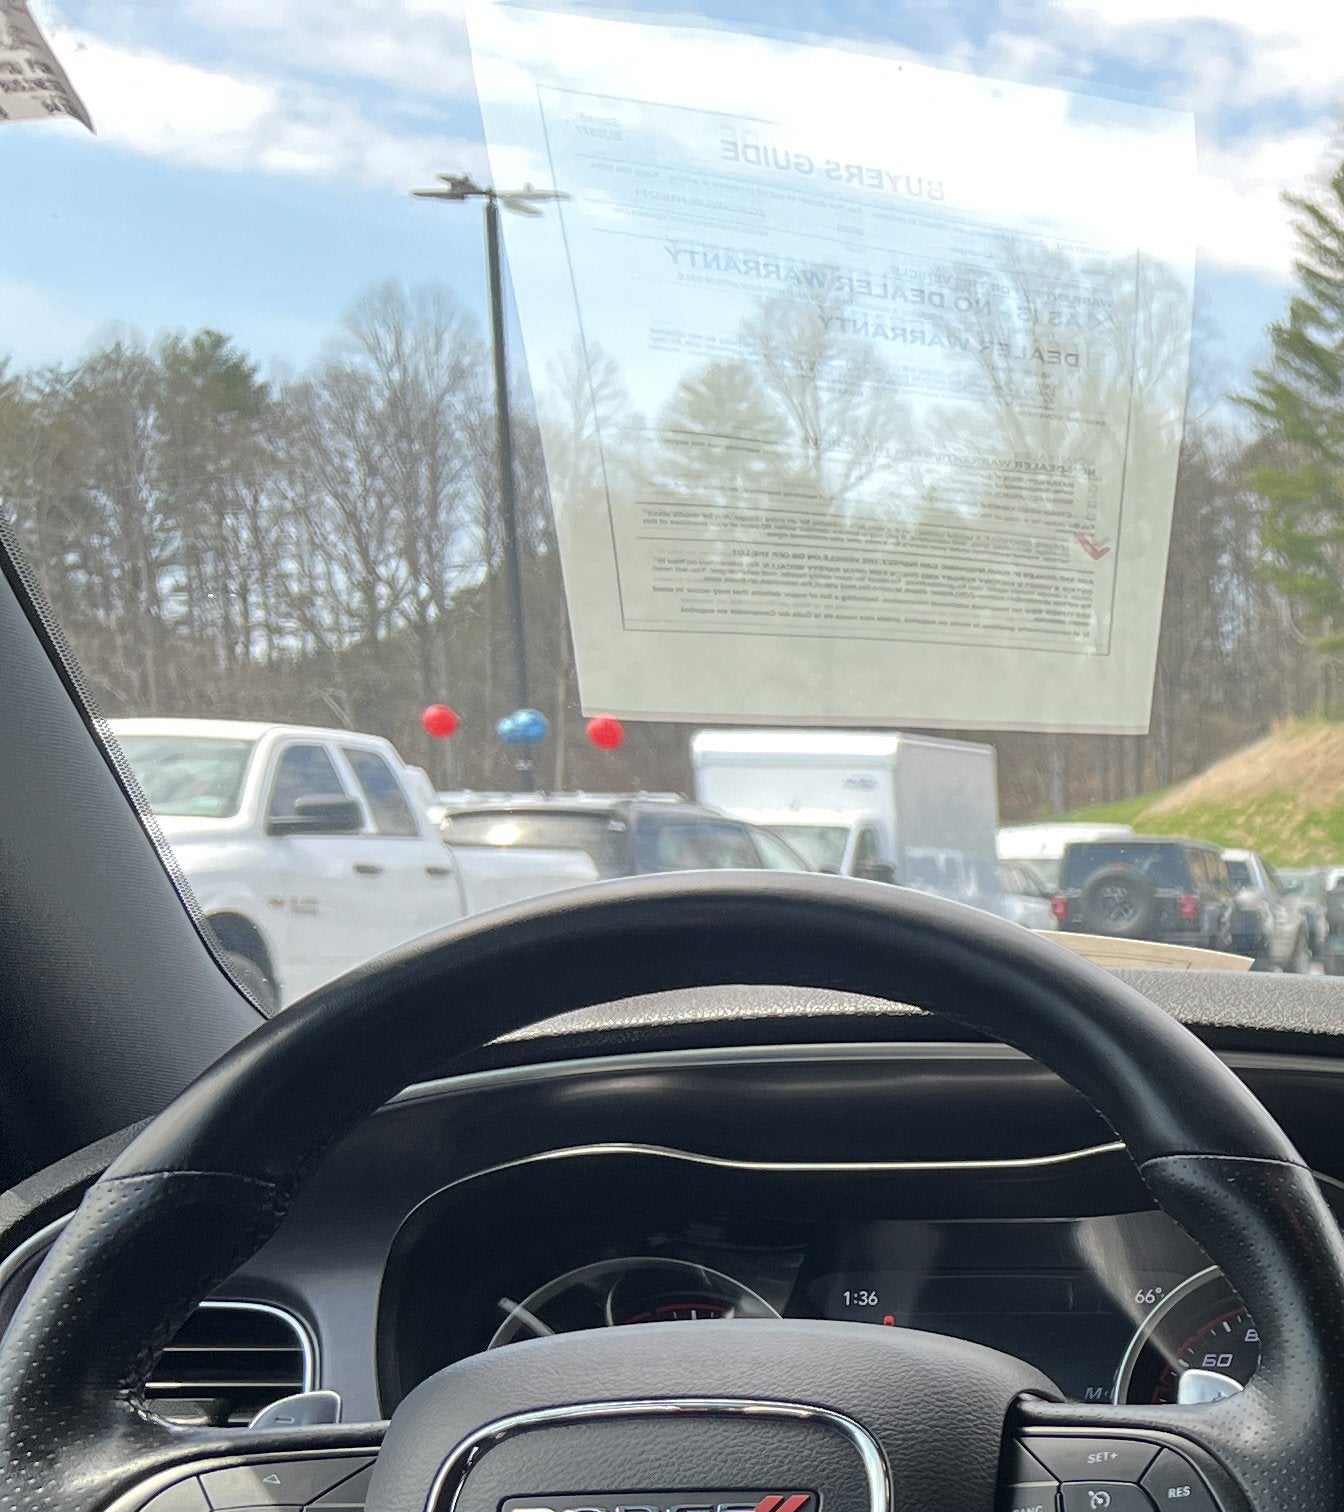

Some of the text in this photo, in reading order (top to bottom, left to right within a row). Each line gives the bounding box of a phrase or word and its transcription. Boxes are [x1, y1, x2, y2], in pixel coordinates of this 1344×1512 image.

[843, 1290, 879, 1307] 1:36
[1201, 1353, 1234, 1368] 60
[1167, 1485, 1191, 1499] RES
